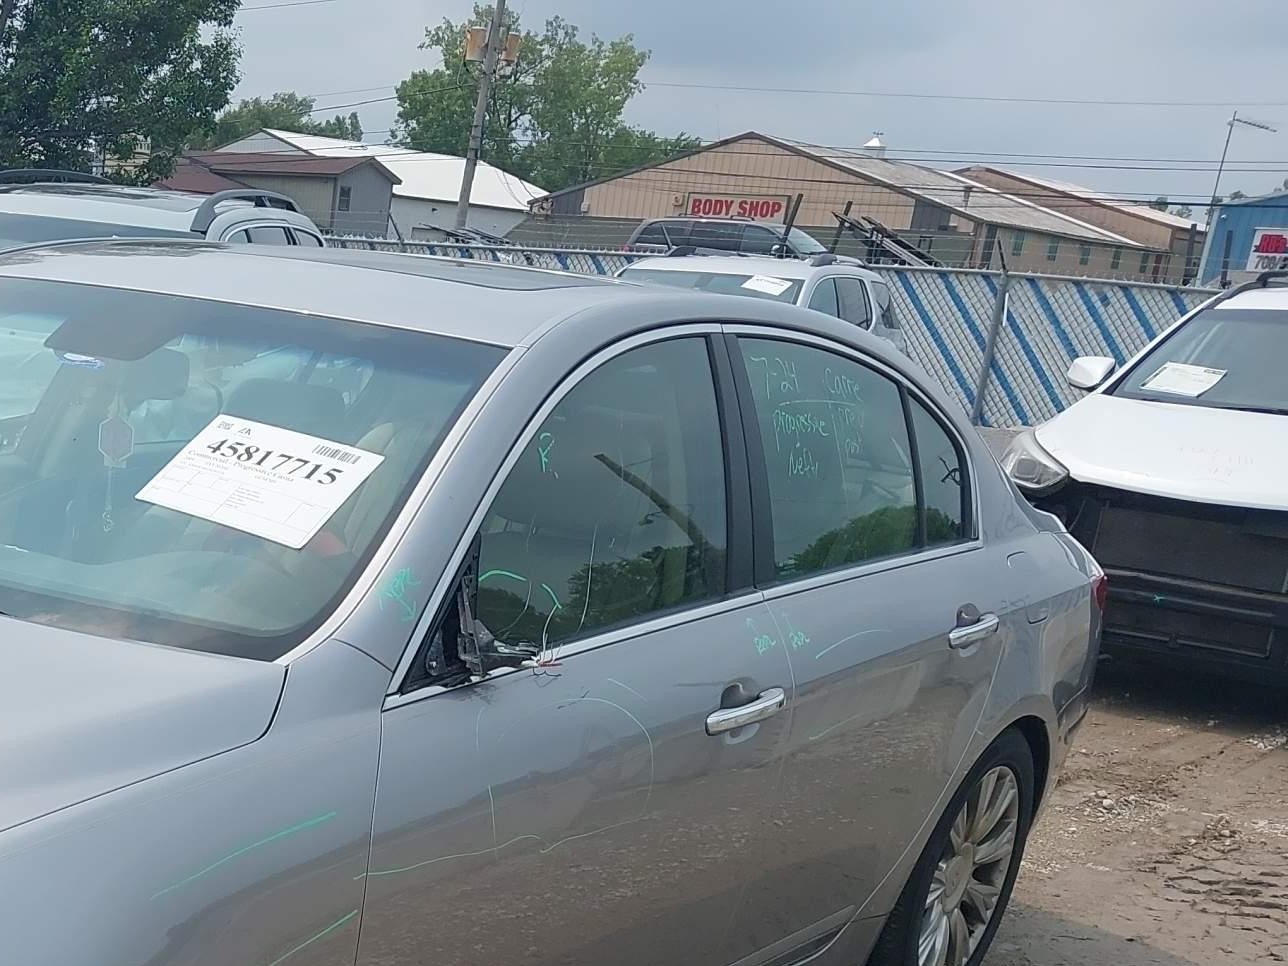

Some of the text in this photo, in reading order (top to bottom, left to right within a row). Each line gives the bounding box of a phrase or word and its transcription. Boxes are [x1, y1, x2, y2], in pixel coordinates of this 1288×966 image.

[691, 198, 783, 218] BODY SHOP
[206, 439, 344, 485] 45817715
